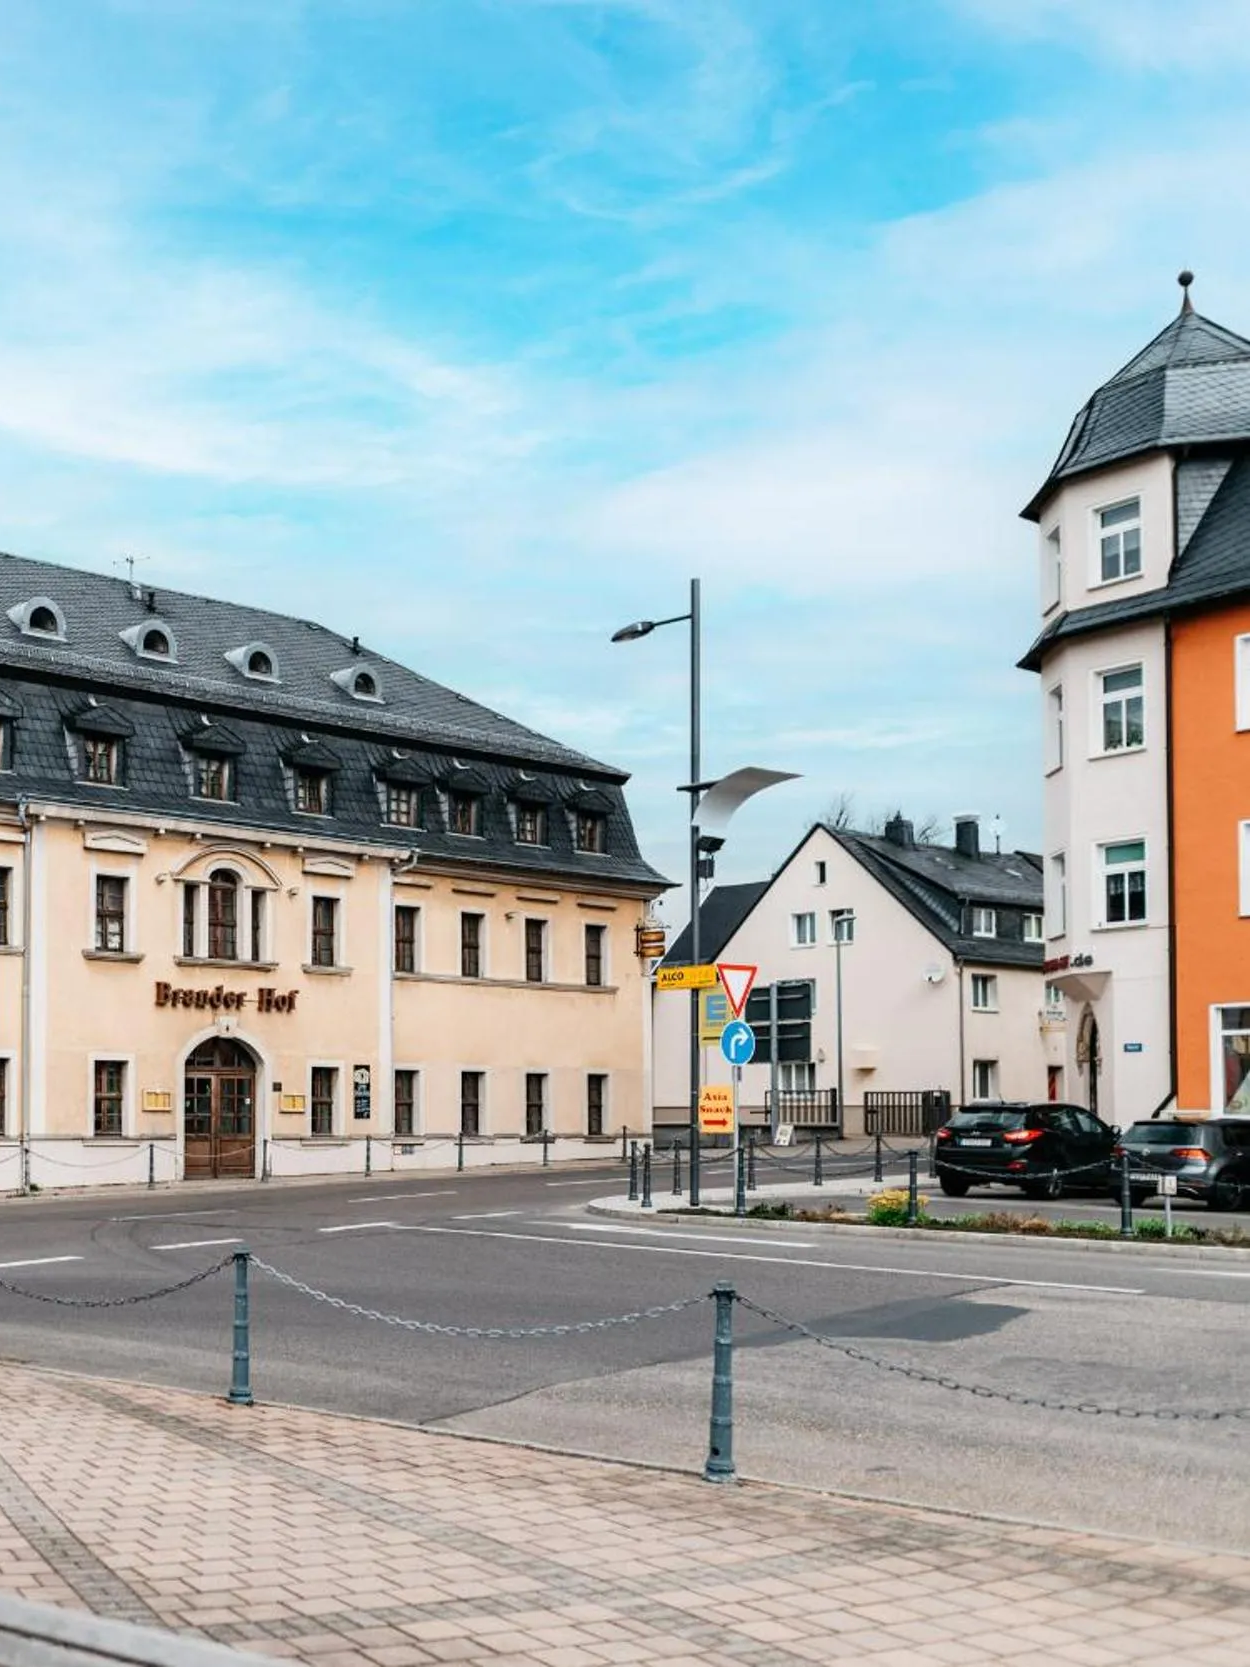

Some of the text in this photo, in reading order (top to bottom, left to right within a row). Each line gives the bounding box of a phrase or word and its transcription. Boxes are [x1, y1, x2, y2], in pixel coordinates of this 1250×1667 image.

[661, 971, 684, 983] ALCO
[154, 981, 299, 1013] Brander Hof
[704, 1092, 728, 1101] Asia
[699, 1105, 732, 1114] Snack
